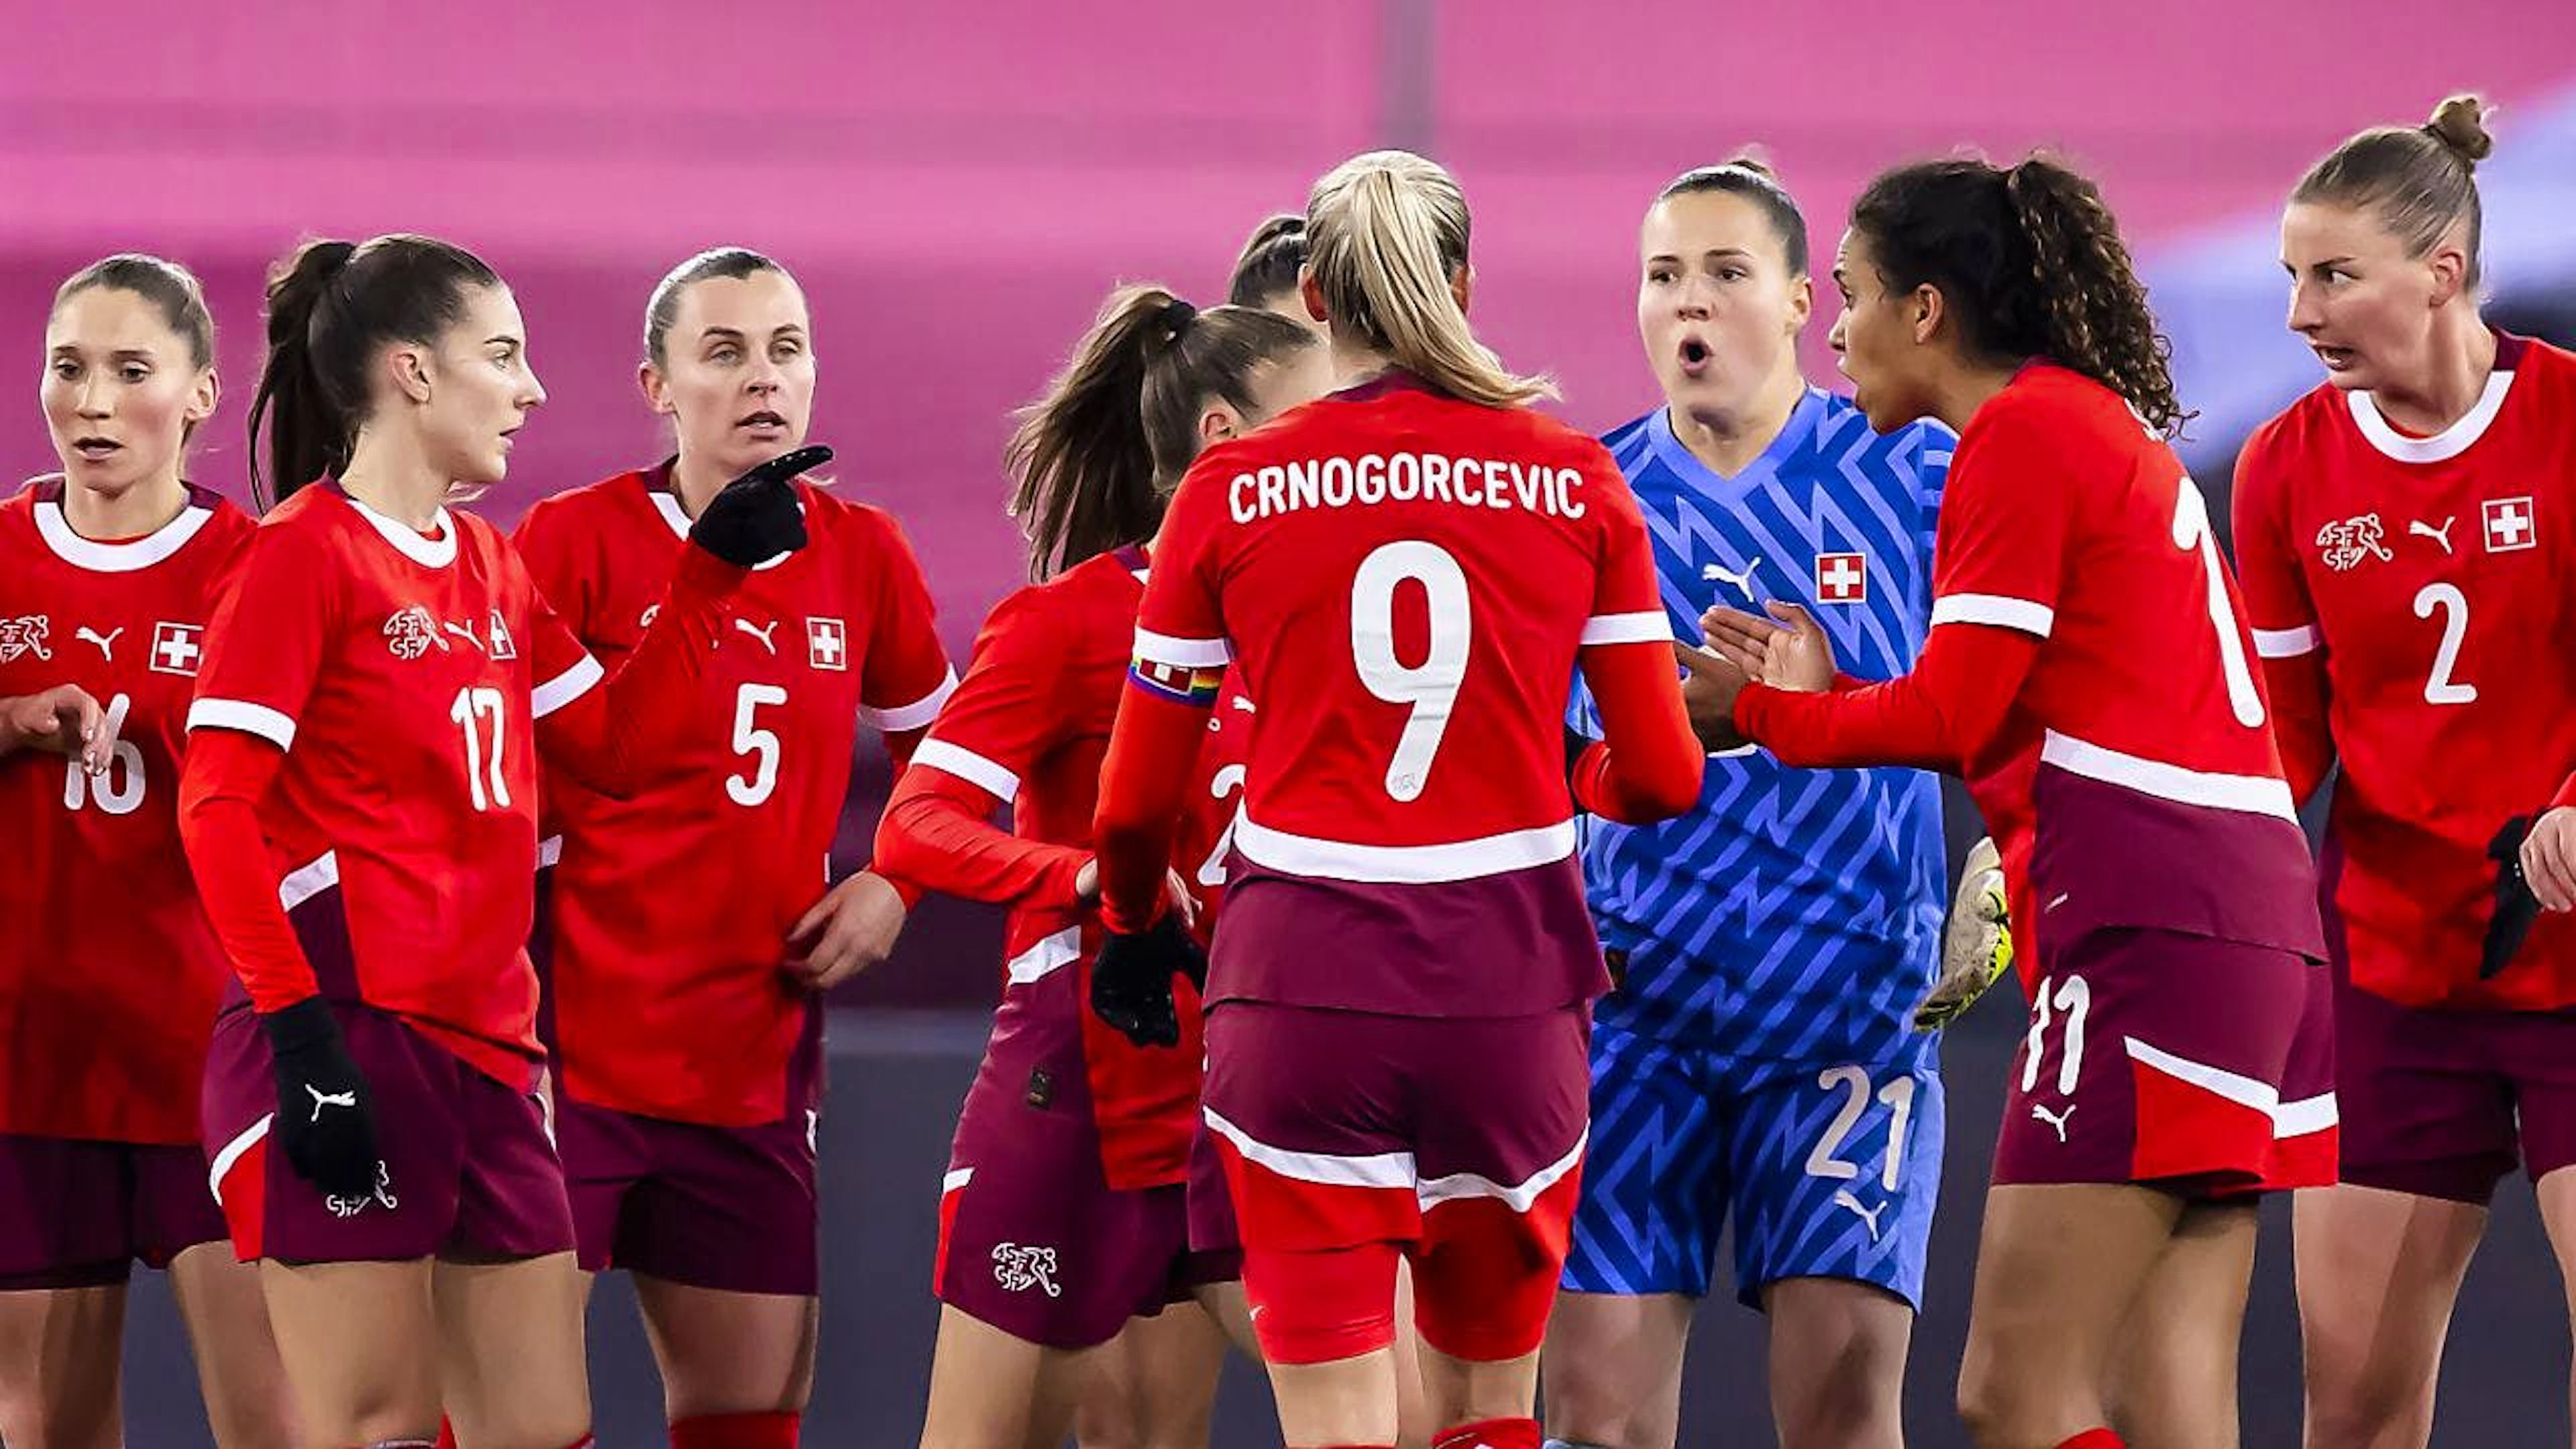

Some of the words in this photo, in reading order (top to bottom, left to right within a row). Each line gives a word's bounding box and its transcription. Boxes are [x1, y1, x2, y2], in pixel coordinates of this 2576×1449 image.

[1228, 452, 1586, 523] CRNOGORCEVIC
[1350, 539, 1472, 802] 9
[2414, 582, 2477, 704] 2
[450, 687, 511, 811] 17
[725, 683, 787, 806] 5
[2021, 975, 2090, 1096] 11
[1805, 1065, 1915, 1192] 21
